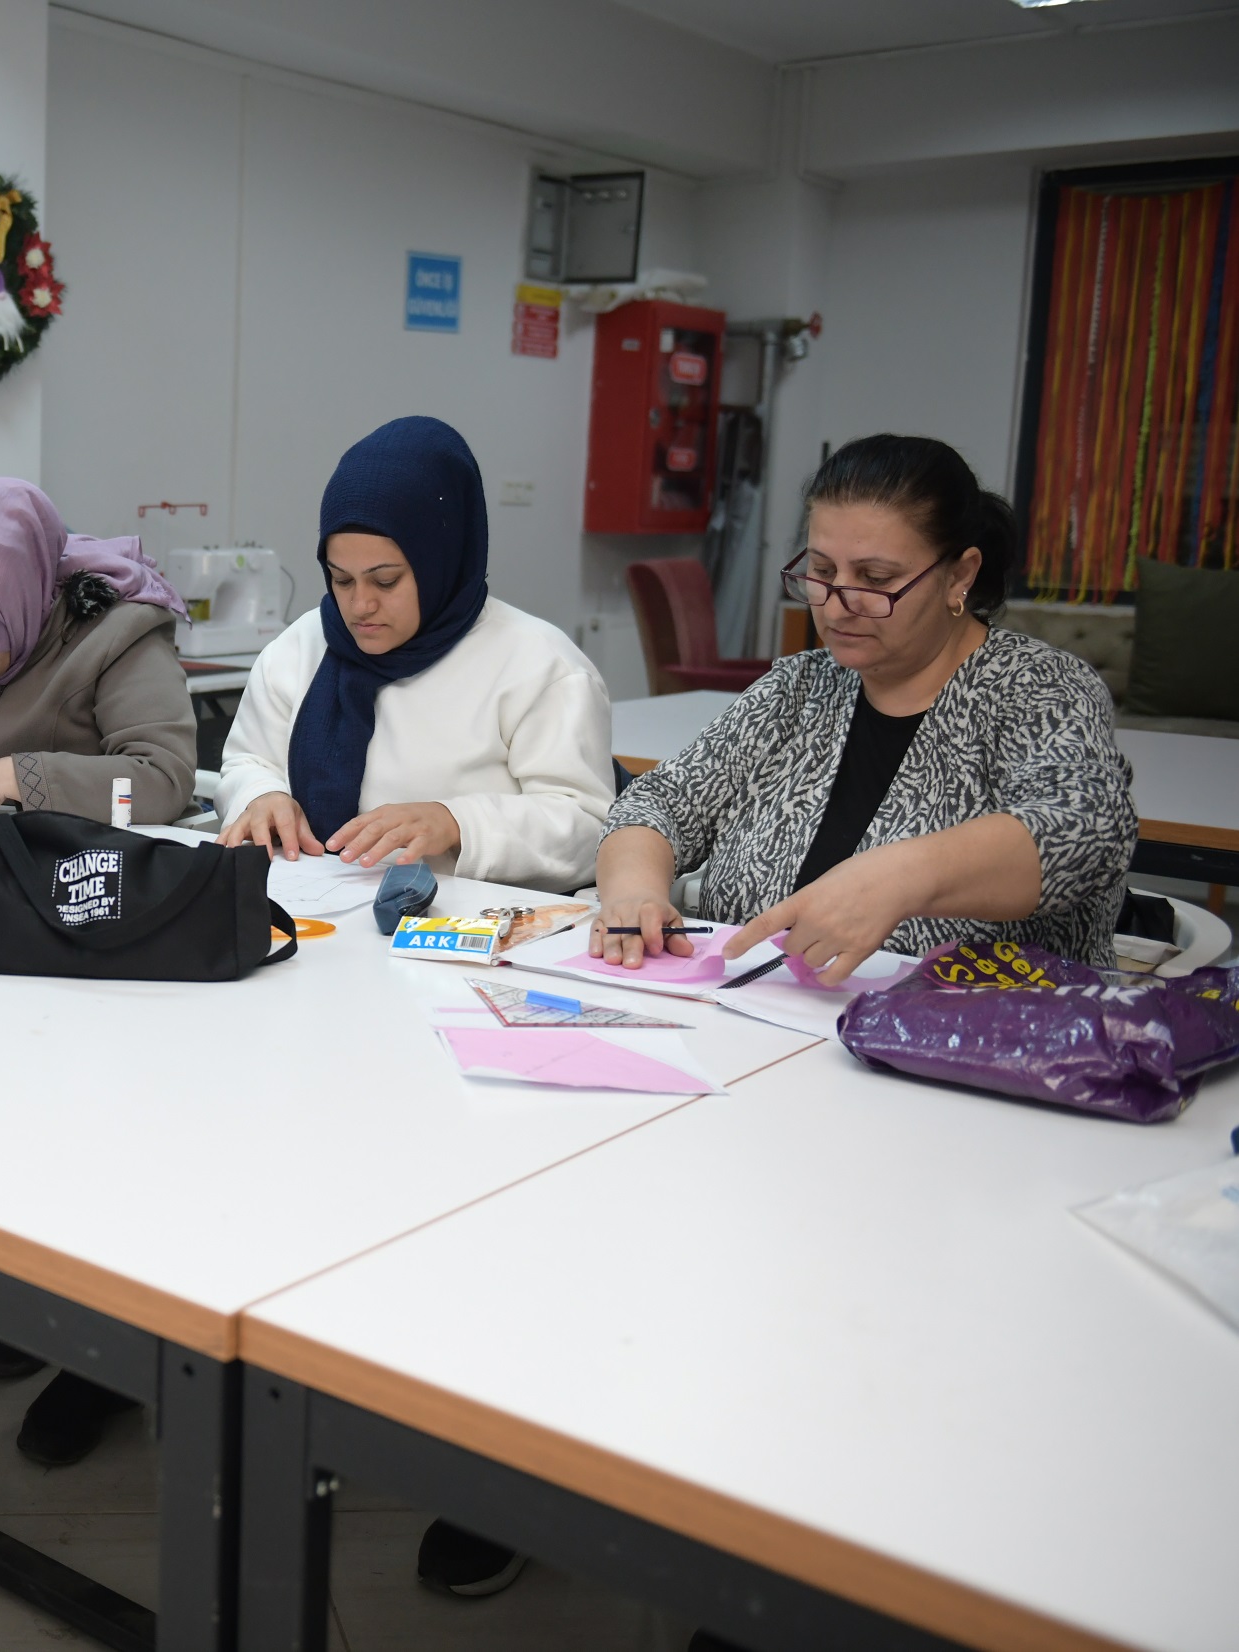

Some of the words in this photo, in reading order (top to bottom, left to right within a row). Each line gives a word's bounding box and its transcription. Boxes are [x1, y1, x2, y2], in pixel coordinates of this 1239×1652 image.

[58, 853, 119, 883] CHANGE
[68, 875, 106, 904] TIME
[101, 897, 116, 906] BY
[90, 906, 110, 918] 1961
[408, 934, 452, 948] ARK
